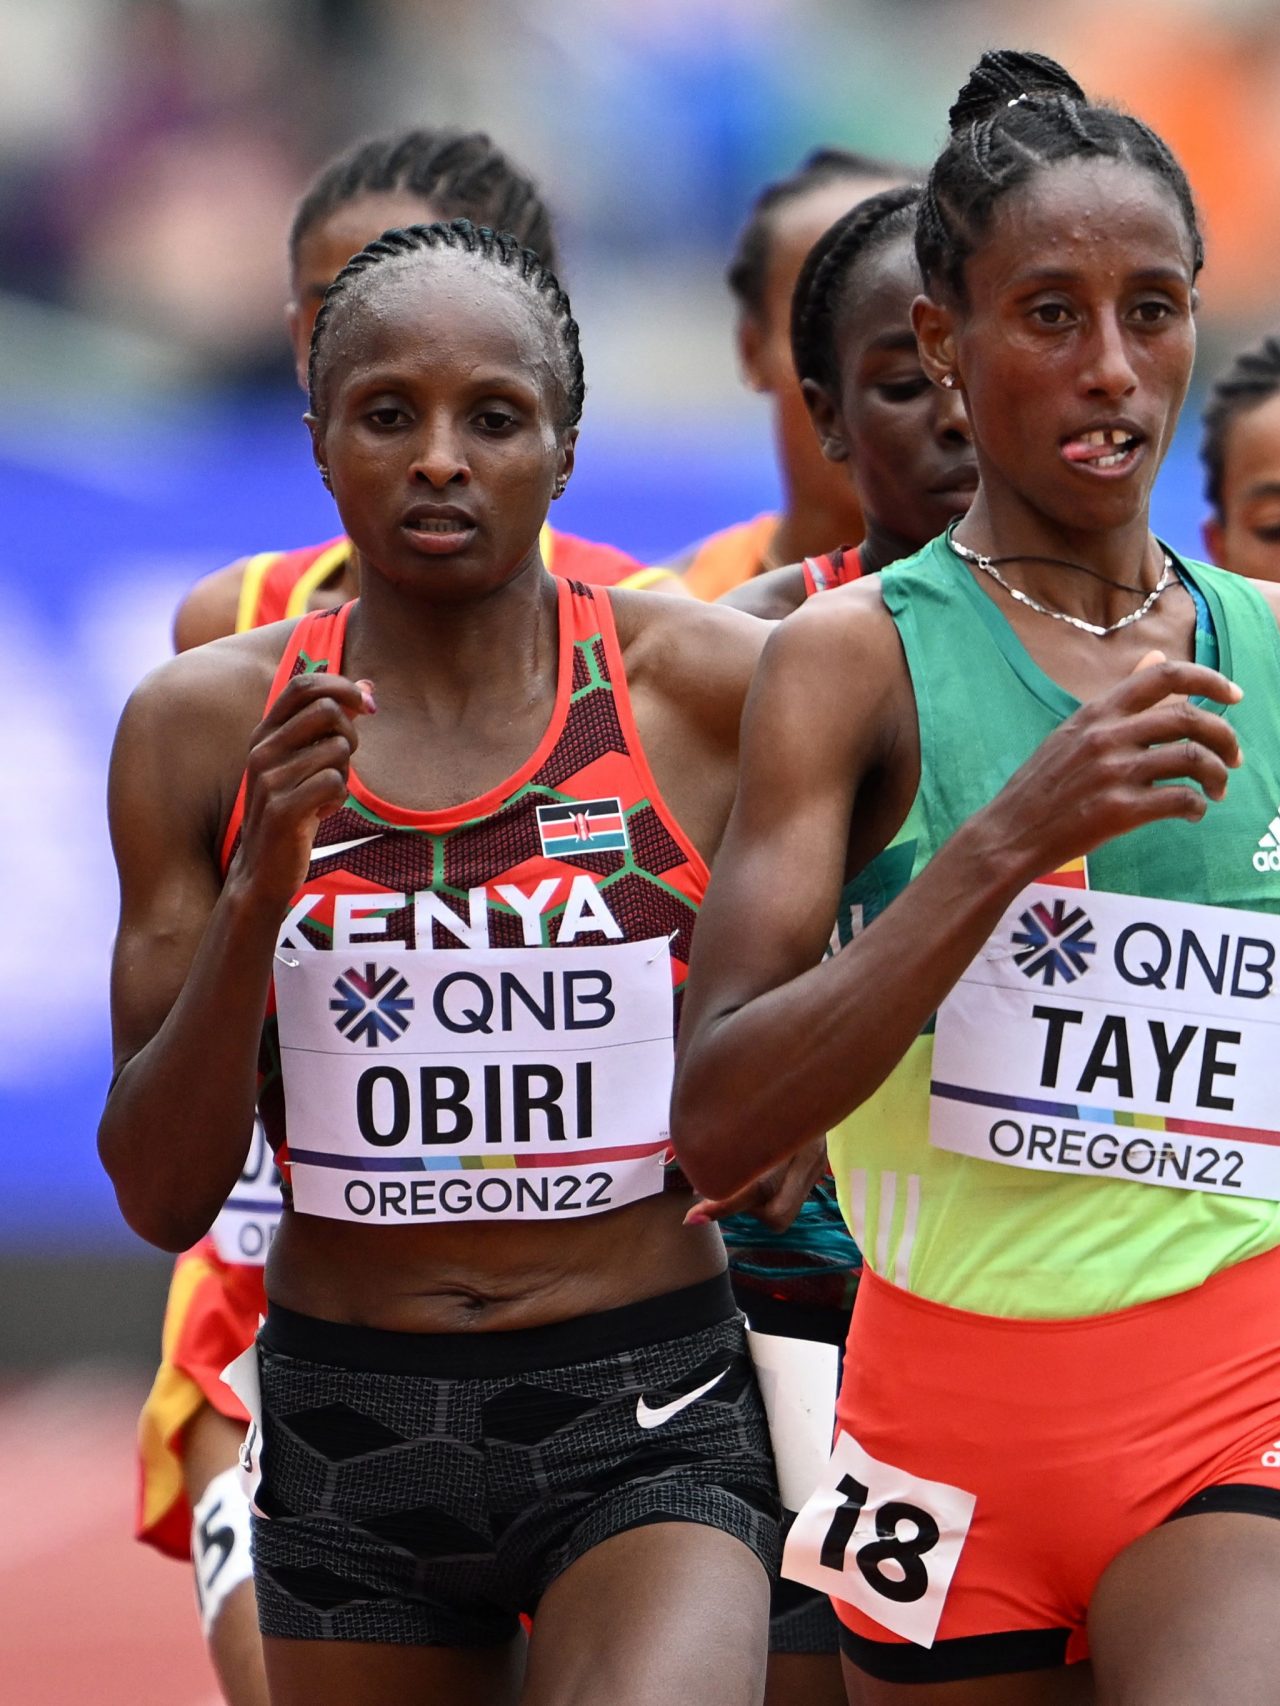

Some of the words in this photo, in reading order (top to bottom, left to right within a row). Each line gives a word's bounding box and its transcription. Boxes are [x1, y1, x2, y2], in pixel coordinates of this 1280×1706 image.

[276, 875, 624, 950] KENYA
[1114, 922, 1276, 999] QNB
[433, 970, 616, 1034] QNB
[1032, 1005, 1242, 1112] TAYE
[356, 1062, 593, 1147] OBIRI
[989, 1119, 1244, 1188] OREGON22
[344, 1172, 614, 1216] OREGON22
[819, 1473, 940, 1603] 18
